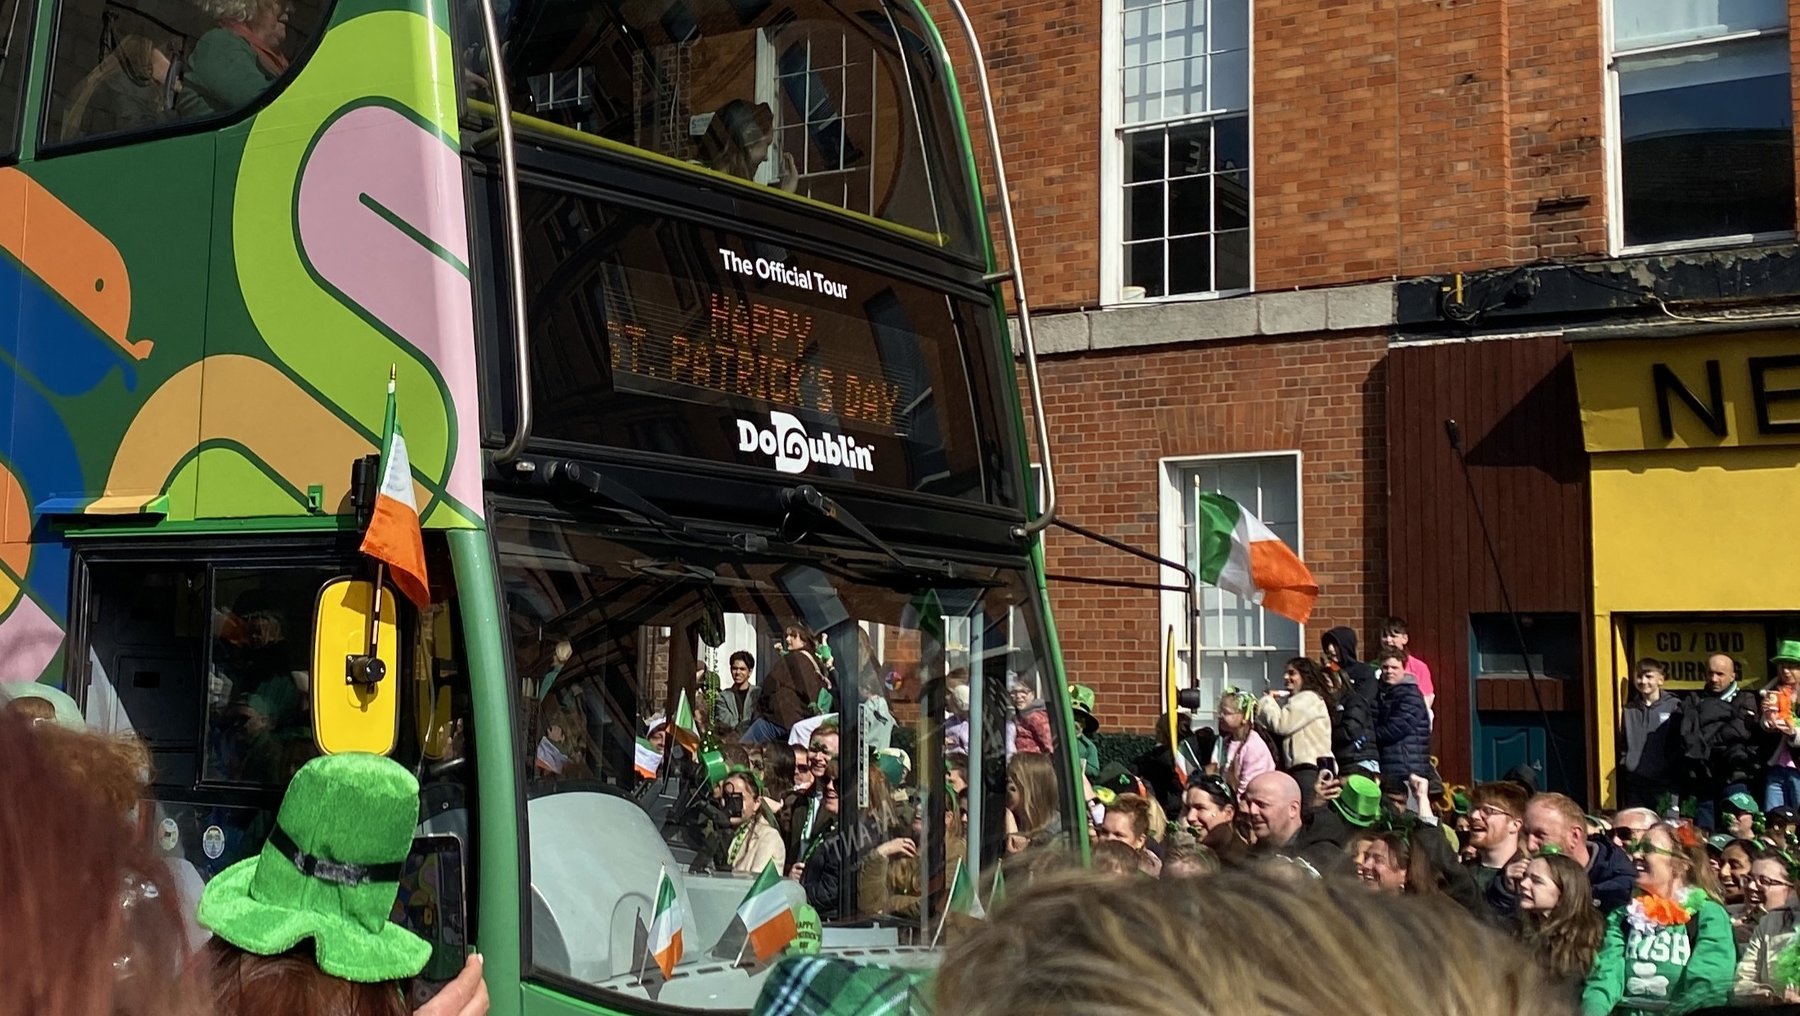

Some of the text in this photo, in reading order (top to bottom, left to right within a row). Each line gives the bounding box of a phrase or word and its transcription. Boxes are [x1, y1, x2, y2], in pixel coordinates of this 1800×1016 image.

[719, 248, 848, 299] The Official Tour
[711, 293, 812, 358] HAPPY
[672, 335, 833, 412] PATRICK'S
[845, 374, 899, 425] DAY
[1656, 632, 1682, 652] CD
[1705, 632, 1744, 652] DVD
[1660, 661, 1743, 682] BURNG
[1627, 929, 1691, 966] RISH
